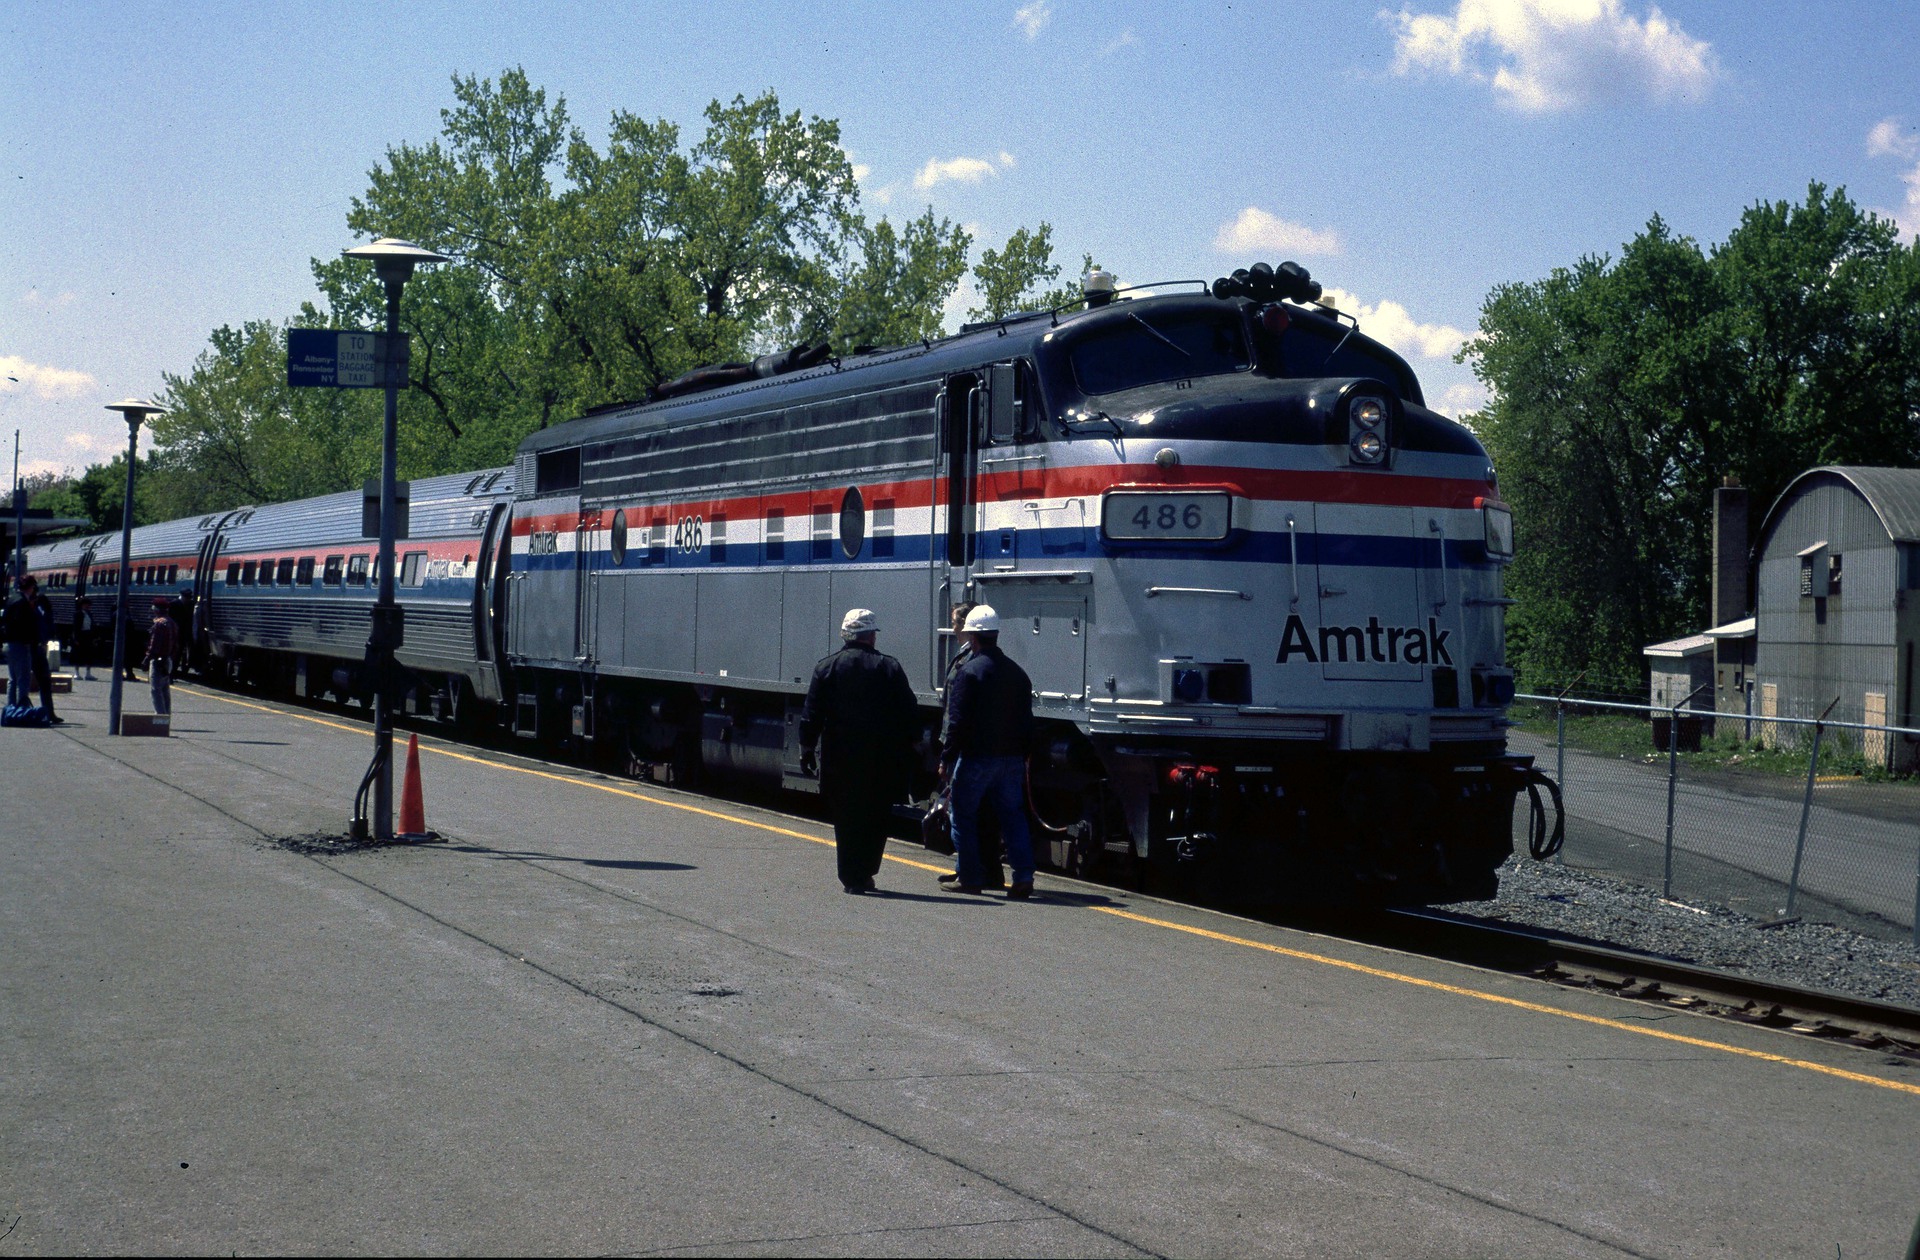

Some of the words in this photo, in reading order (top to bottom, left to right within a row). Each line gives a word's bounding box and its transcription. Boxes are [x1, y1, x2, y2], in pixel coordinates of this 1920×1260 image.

[350, 336, 365, 350] TO
[340, 352, 376, 361] STATION
[338, 362, 377, 372] BAGGAGE
[321, 375, 335, 383] NY
[348, 373, 367, 382] TAXI
[1131, 503, 1202, 530] 486
[528, 524, 559, 555] Amtrak
[674, 515, 703, 554] 486
[1275, 613, 1454, 666] Amtrak
[1086, 685, 1091, 698] F
